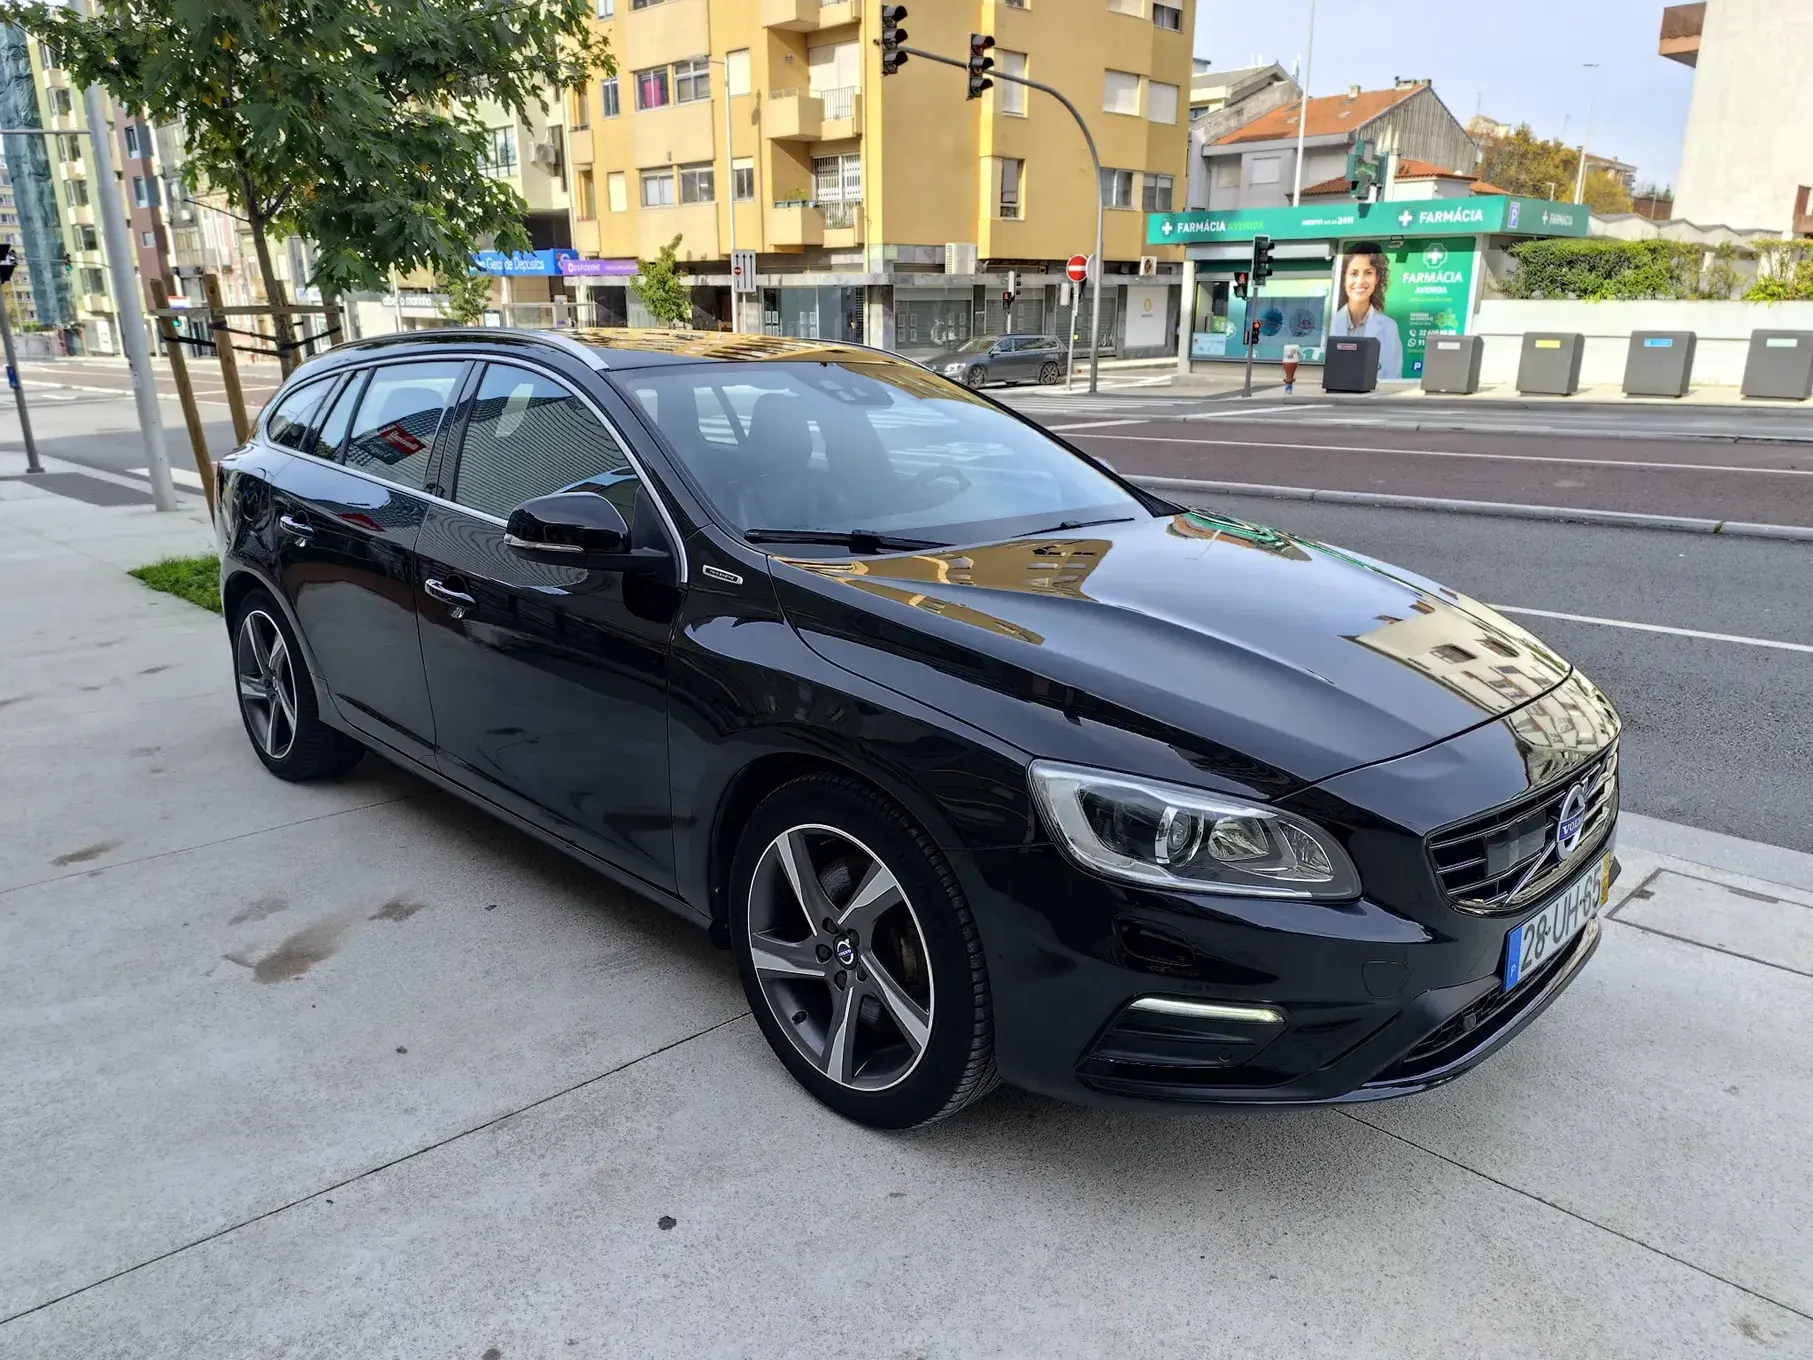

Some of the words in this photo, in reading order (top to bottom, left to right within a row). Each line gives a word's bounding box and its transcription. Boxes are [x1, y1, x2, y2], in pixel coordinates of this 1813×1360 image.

[1419, 206, 1483, 224] FARMÁCIA
[1177, 219, 1226, 233] FARMÁCIA
[1402, 269, 1463, 284] FARMÁCIA
